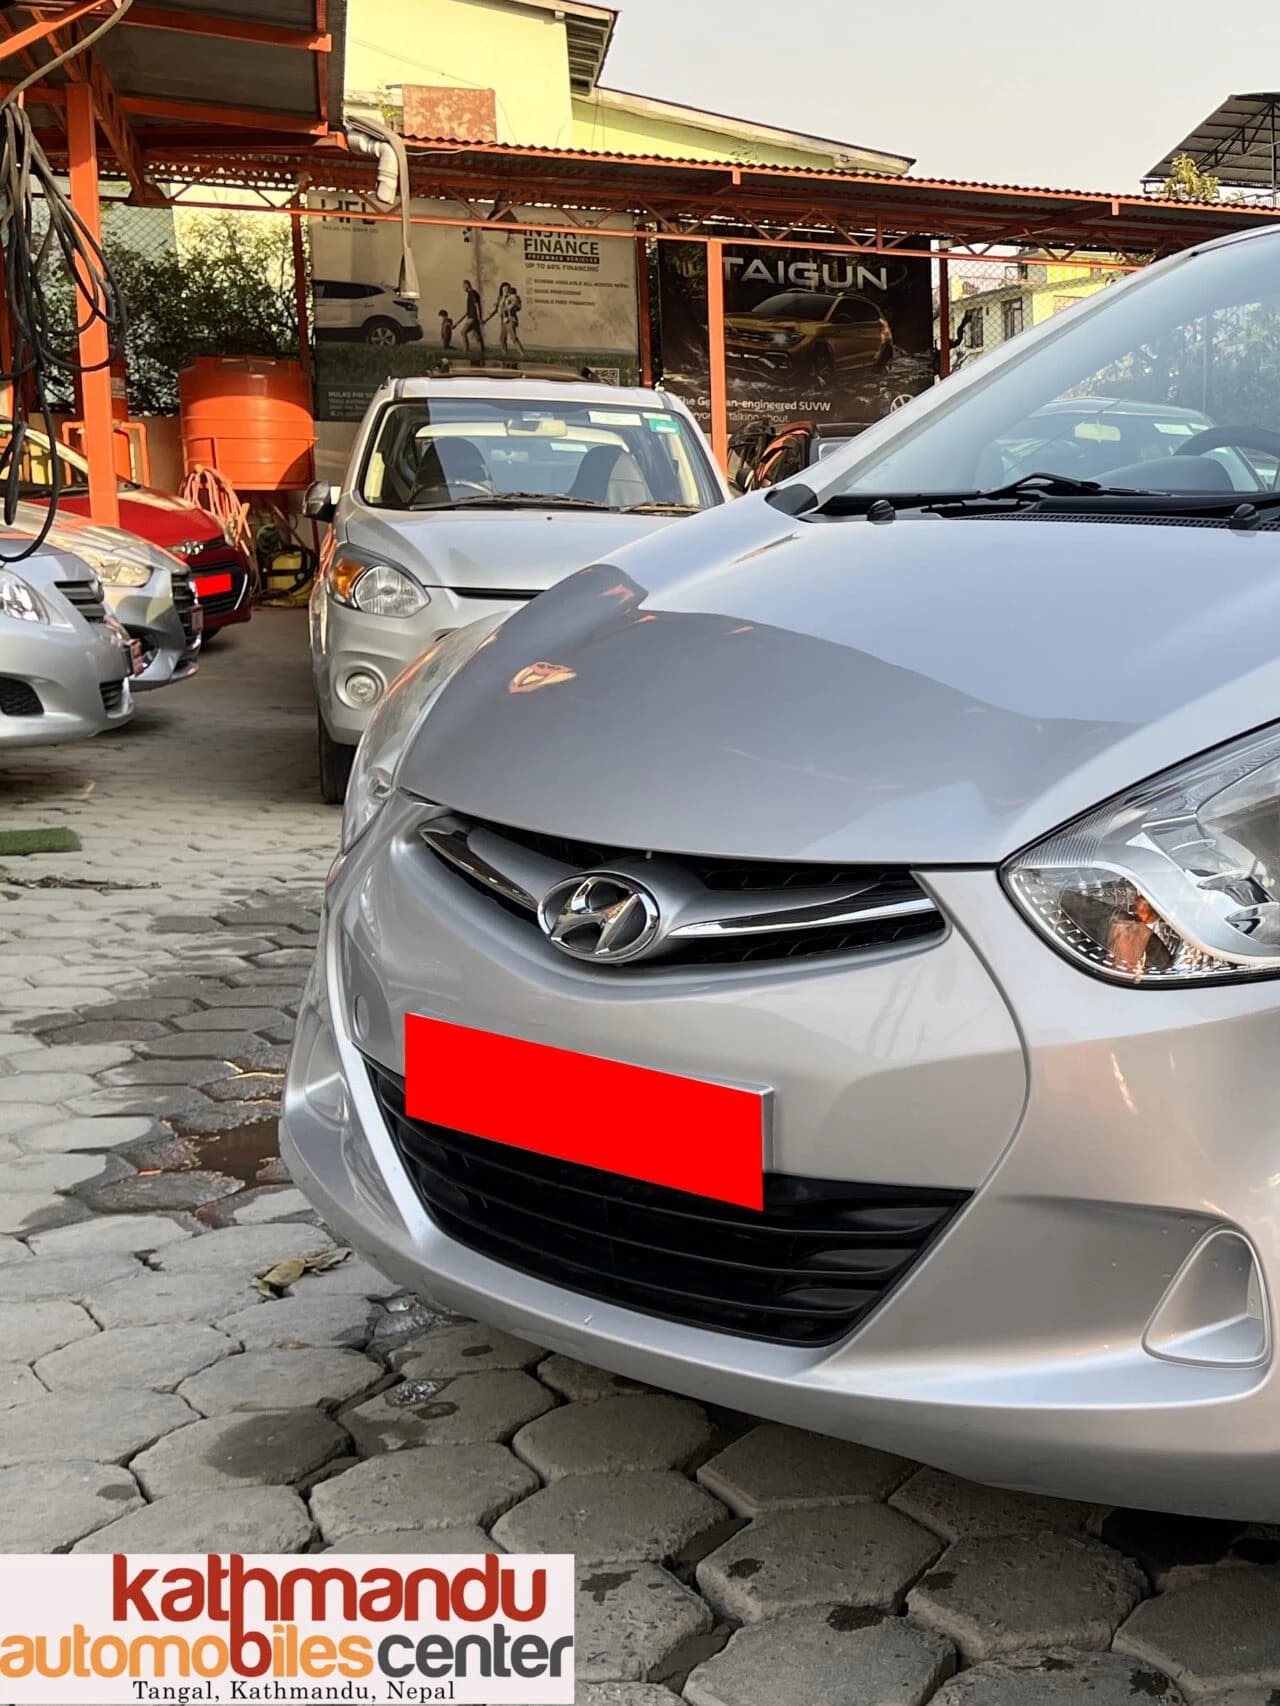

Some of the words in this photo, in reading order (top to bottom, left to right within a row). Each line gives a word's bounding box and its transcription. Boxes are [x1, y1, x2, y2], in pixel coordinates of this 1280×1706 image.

[524, 238, 599, 256] FINANCE
[722, 256, 887, 291] TAIGUN
[798, 400, 831, 411] SUVW
